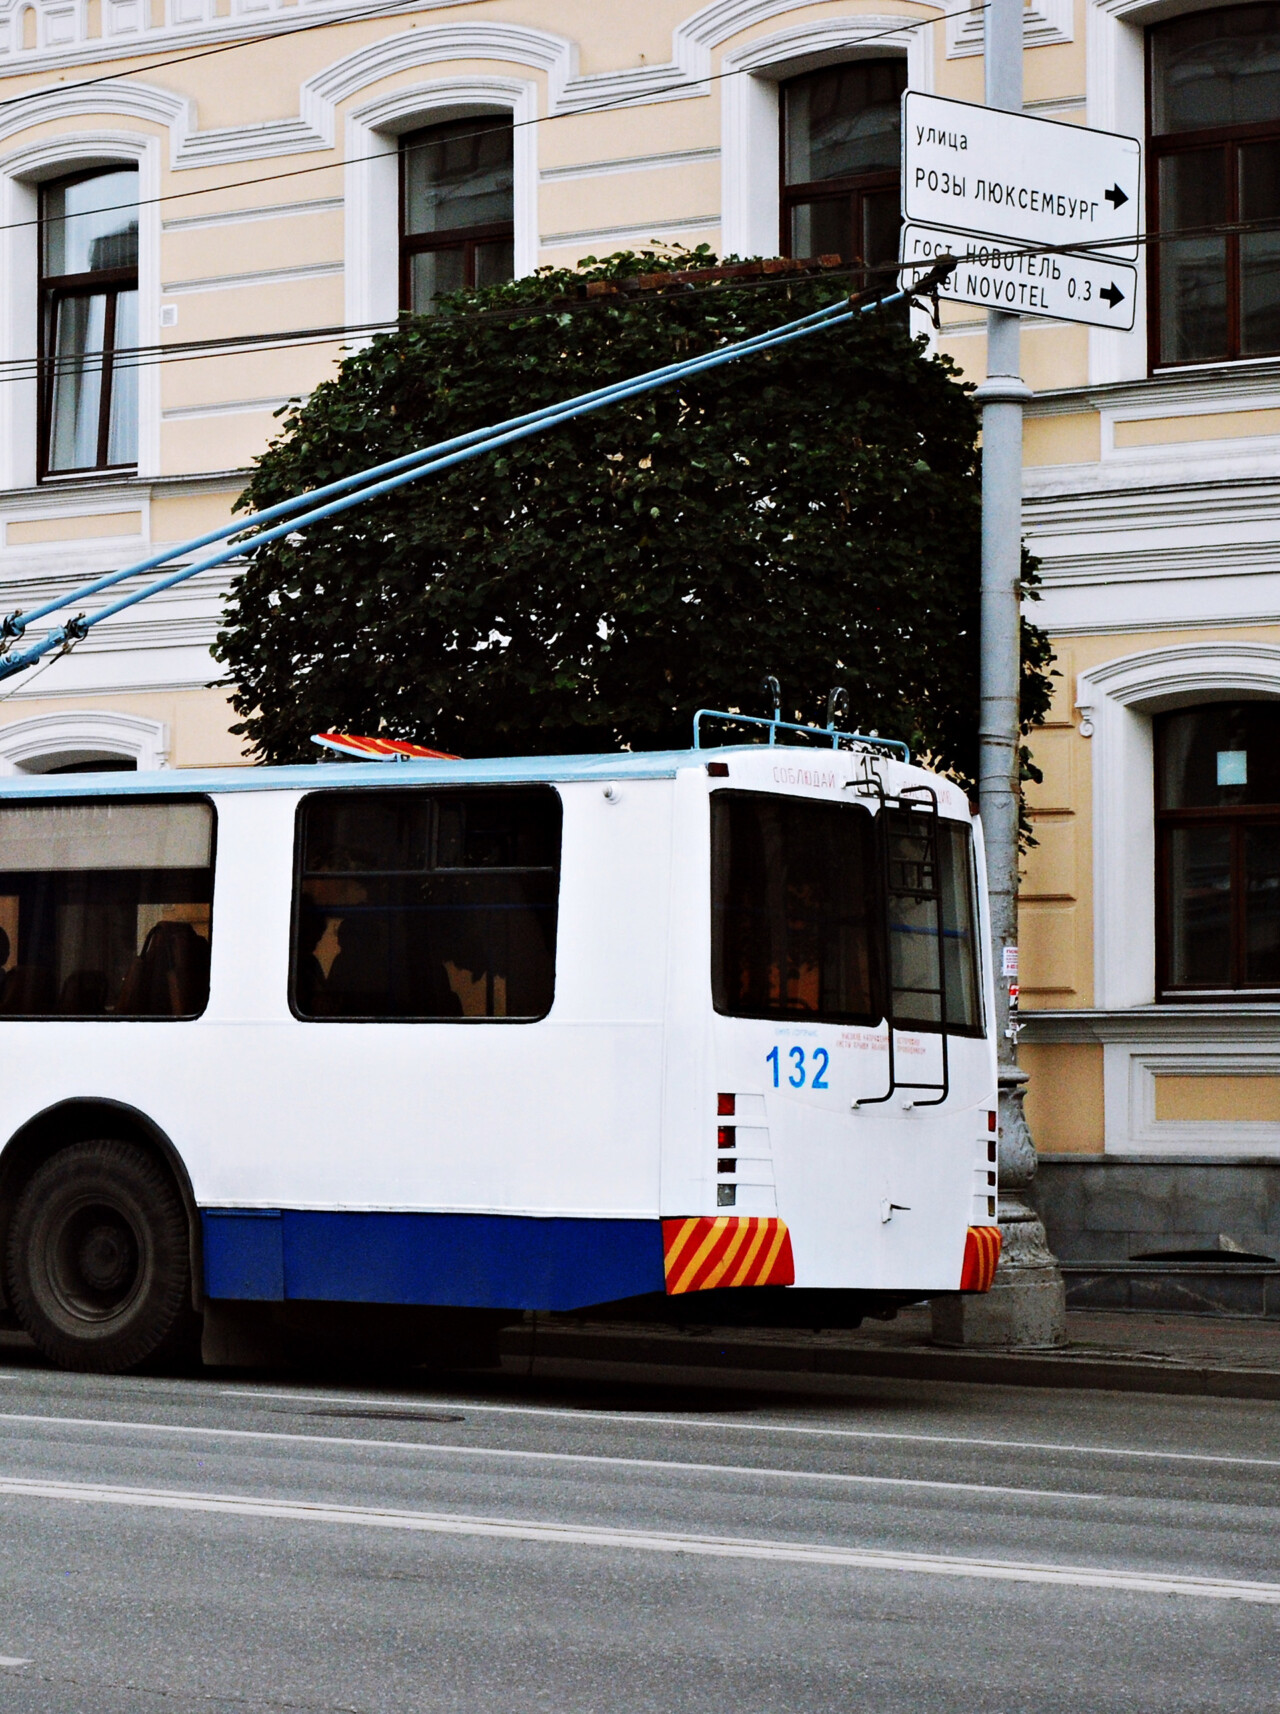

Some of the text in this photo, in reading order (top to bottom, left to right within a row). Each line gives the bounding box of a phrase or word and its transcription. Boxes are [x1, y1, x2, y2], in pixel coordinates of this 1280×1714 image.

[916, 125, 968, 151] улица
[915, 167, 1099, 222] РОЗЫ ЛЮКСЕМБУРГ
[966, 242, 1062, 280] НОВОТЕЛЬ
[966, 274, 1049, 309] NOVOTEL
[1067, 277, 1092, 301] 0.3
[772, 766, 836, 789] СОБЛЮДАЙ
[766, 1045, 830, 1089] 132
